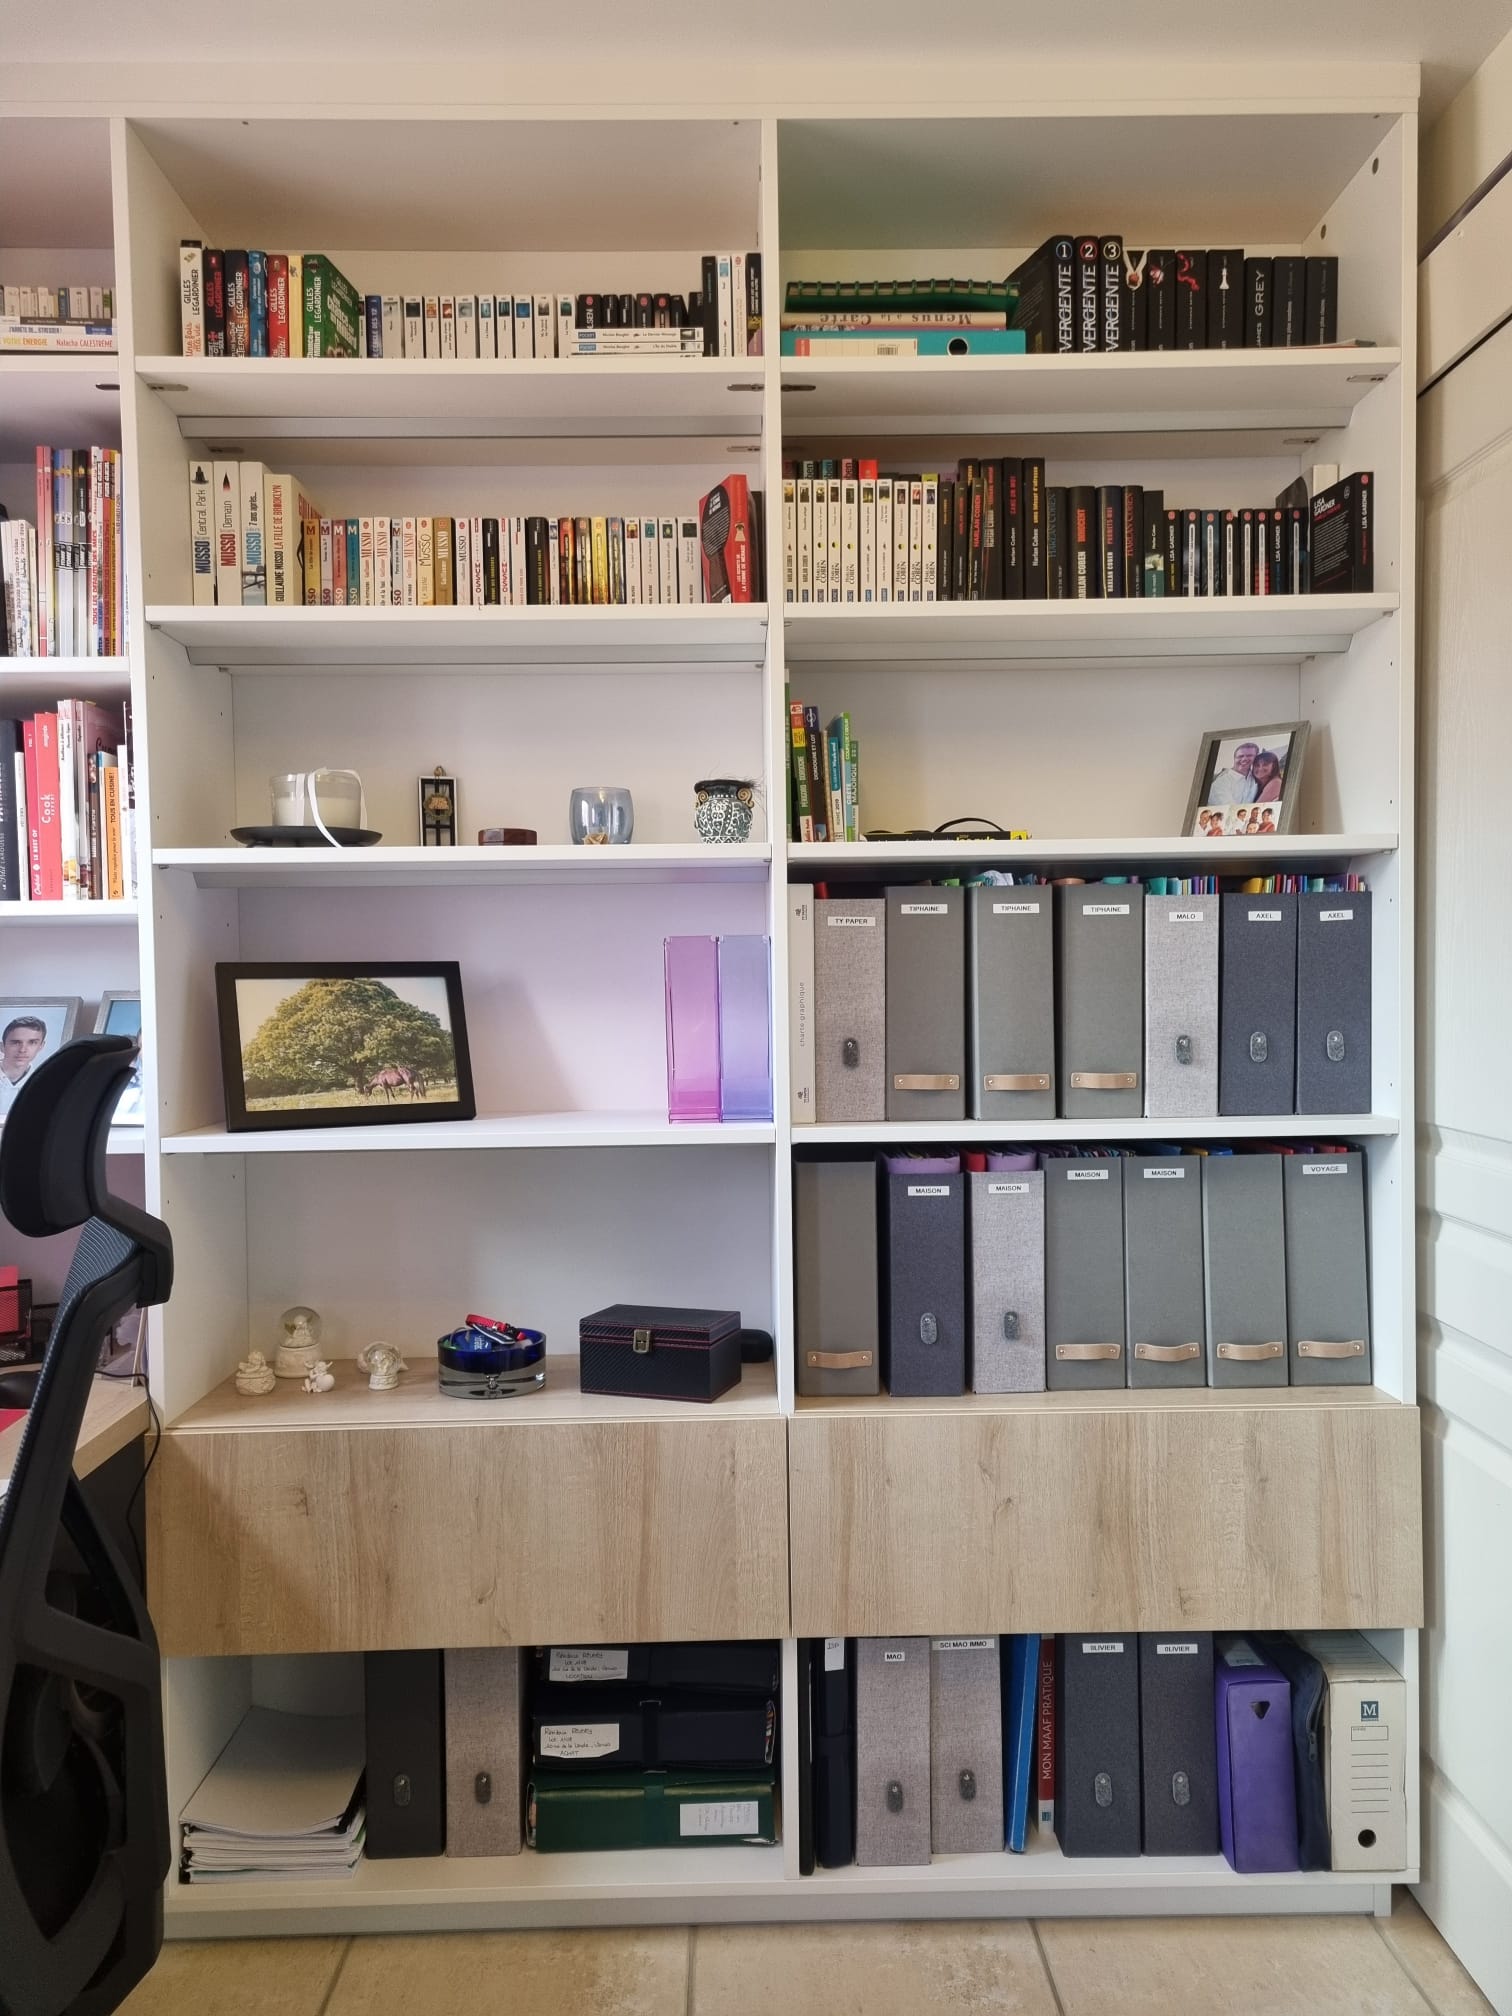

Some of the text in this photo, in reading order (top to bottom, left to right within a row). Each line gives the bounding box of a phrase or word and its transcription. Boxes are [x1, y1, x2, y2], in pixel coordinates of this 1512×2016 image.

[184, 280, 192, 304] GILLES
[192, 269, 200, 315] LEGARDINIER
[206, 282, 214, 307] GILLES
[214, 272, 223, 318] LEGARDINIER
[228, 282, 236, 308] GILLES
[236, 272, 244, 318] LEGARDINIER
[278, 277, 286, 324] LEGARDINIER
[314, 277, 322, 323] LEGARDINIER
[1255, 270, 1265, 316] GREY
[819, 314, 872, 326] Carte
[911, 314, 972, 326] Menus
[1059, 264, 1072, 352] VERGENTE
[1083, 264, 1096, 352] VERGENTE
[1106, 264, 1119, 352] VERGENTE
[195, 490, 211, 574] MUSSO Central Park
[220, 500, 237, 567] MUSSO Demain
[273, 517, 283, 525] DE
[273, 526, 283, 541] FILLE
[1048, 494, 1057, 558] HARLAN COBEN
[1077, 509, 1086, 542] INNOCENT
[246, 532, 262, 566] MUSSO
[274, 542, 283, 550] LA
[361, 533, 372, 558] MUSSO
[377, 532, 388, 558] MUSSO
[404, 534, 414, 558] MUSSO
[437, 531, 449, 559] MUSSO
[459, 536, 467, 562] MUSSO
[1126, 523, 1134, 557] HARLAN
[274, 551, 284, 570] MUSSO
[1078, 551, 1086, 575] COBEN
[274, 572, 285, 602] GUILLAUME
[308, 588, 316, 606] SSO
[323, 589, 331, 606] SSO
[335, 588, 344, 605] SSO
[350, 588, 358, 605] SSO
[40, 794, 52, 824] Cook
[110, 799, 115, 807] EN
[32, 829, 38, 838] OF
[798, 982, 806, 1020] graphique
[1043, 1661, 1053, 1780] MON MAAF PRATIQUE
[1363, 1704, 1377, 1716] M
